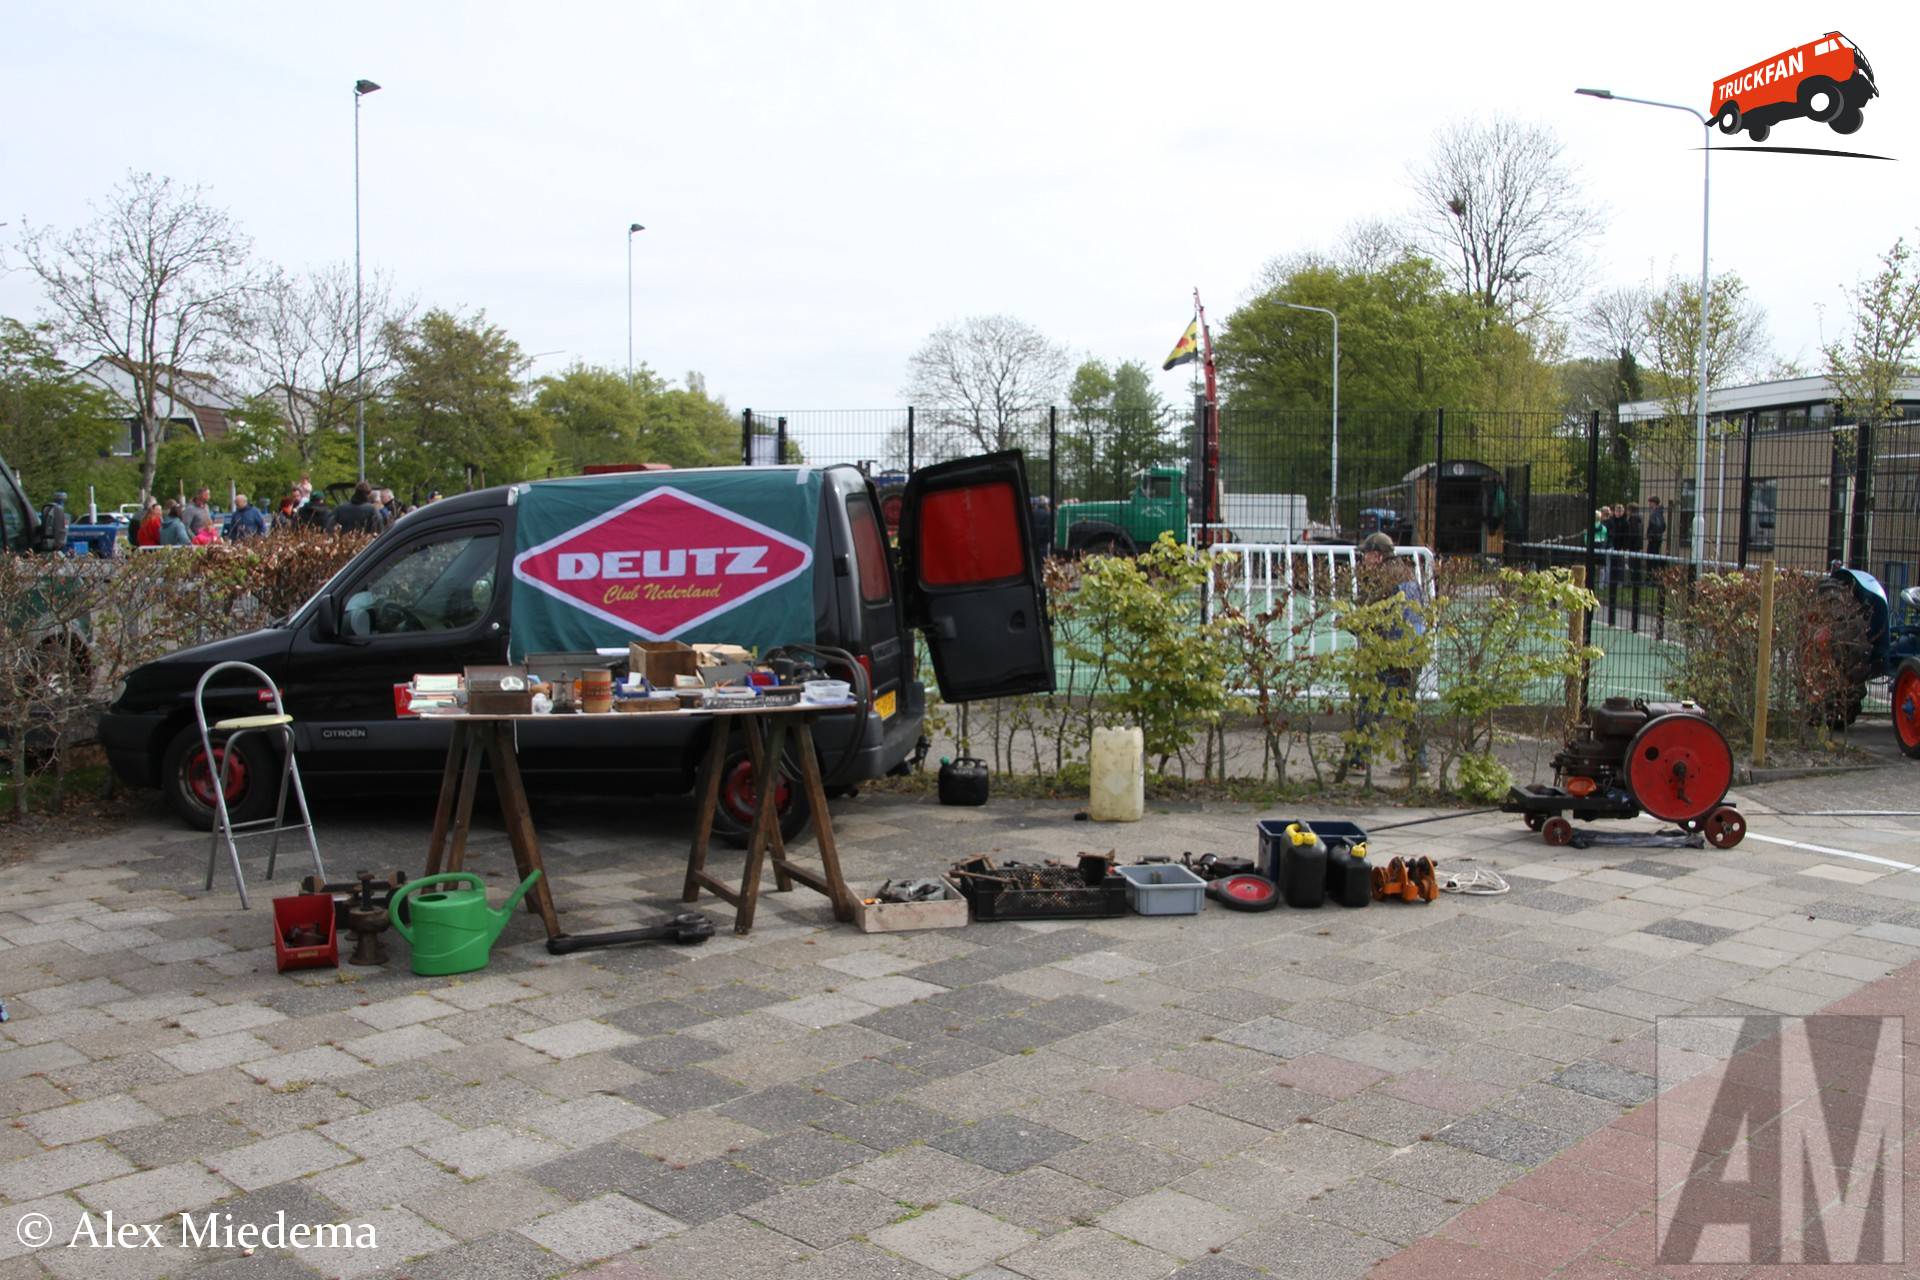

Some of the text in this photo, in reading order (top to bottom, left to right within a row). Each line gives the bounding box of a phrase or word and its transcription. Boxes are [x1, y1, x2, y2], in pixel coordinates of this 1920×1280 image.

[557, 546, 769, 581] DEUTZ
[603, 583, 722, 605] Club Nederland
[322, 728, 366, 738] CITROËN
